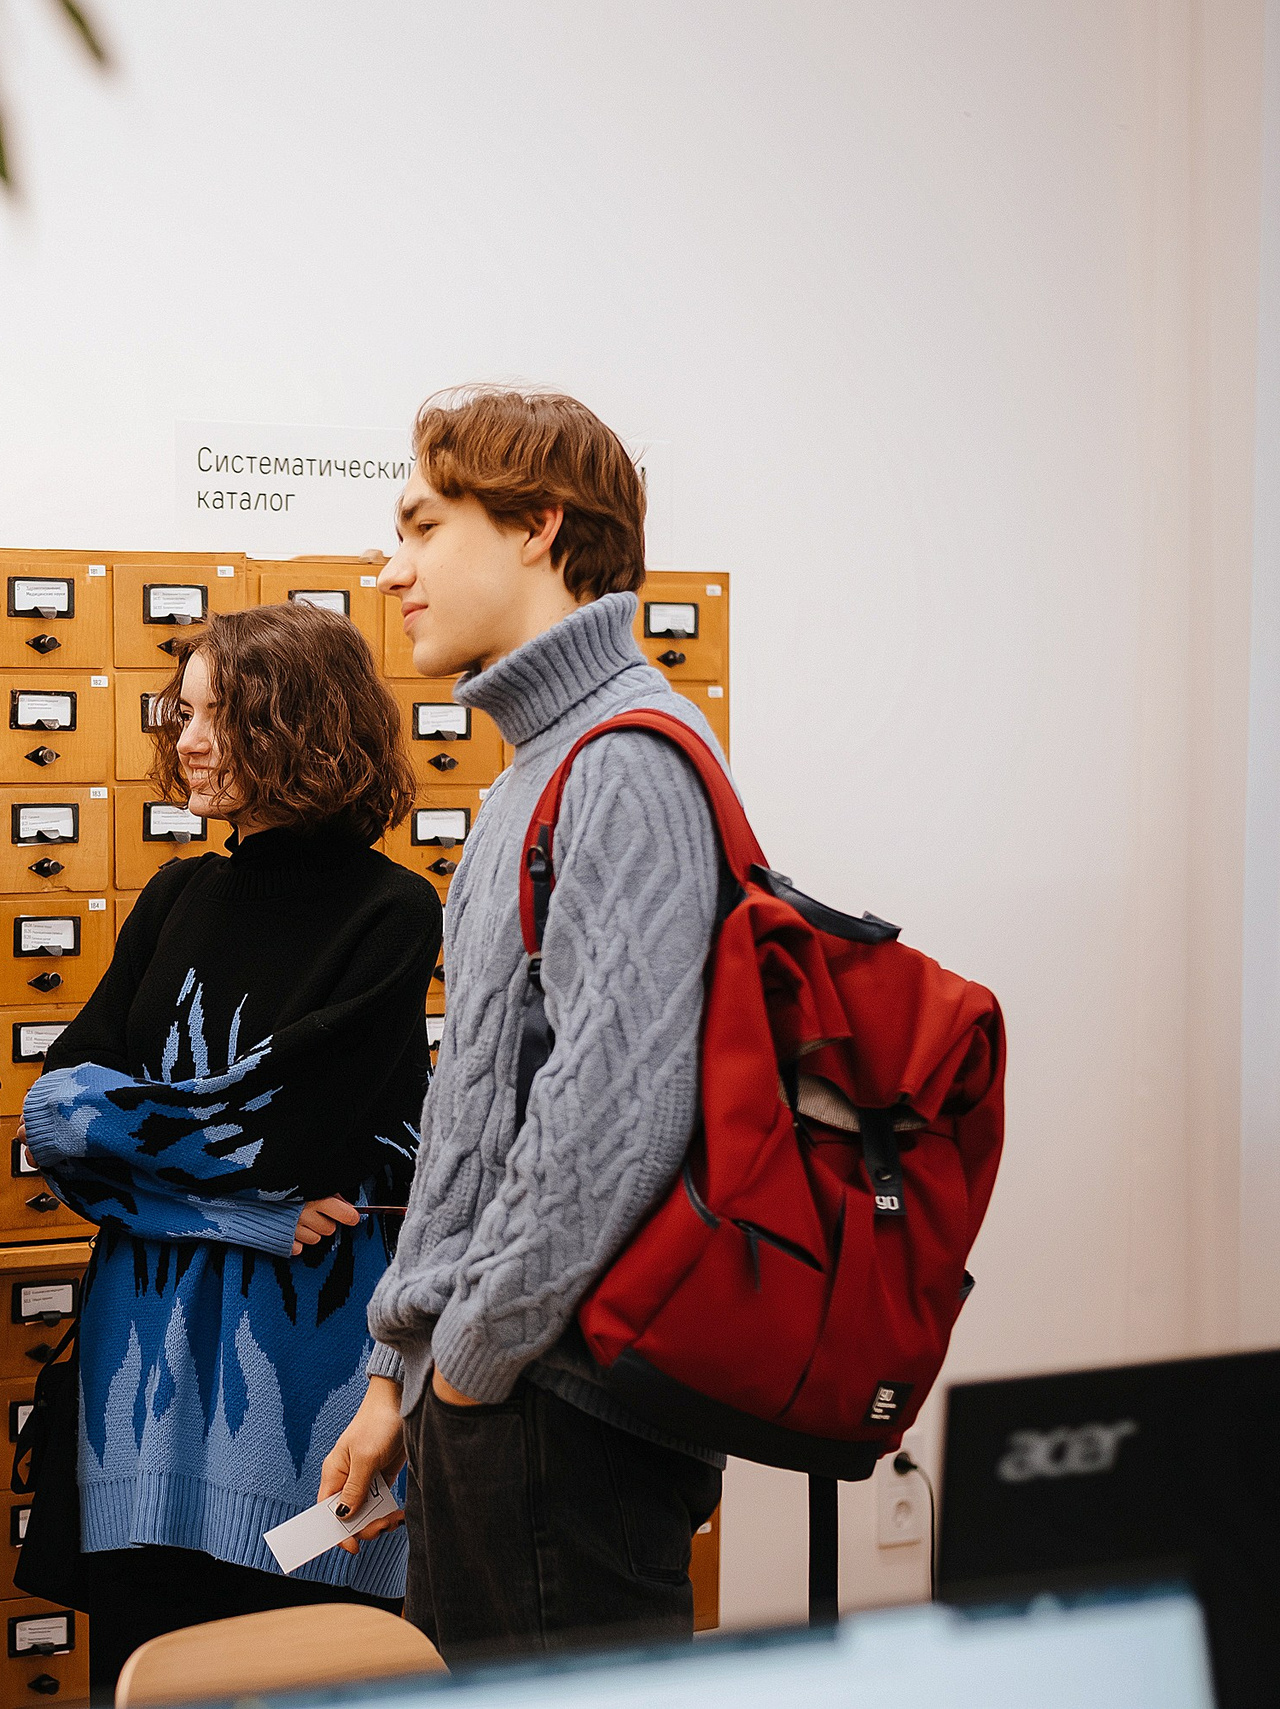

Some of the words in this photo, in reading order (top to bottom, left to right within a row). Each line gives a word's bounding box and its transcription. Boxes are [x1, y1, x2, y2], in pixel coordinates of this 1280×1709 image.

[197, 489, 295, 512] каталог
[875, 1195, 900, 1210] 90
[997, 1419, 1137, 1482] acer
